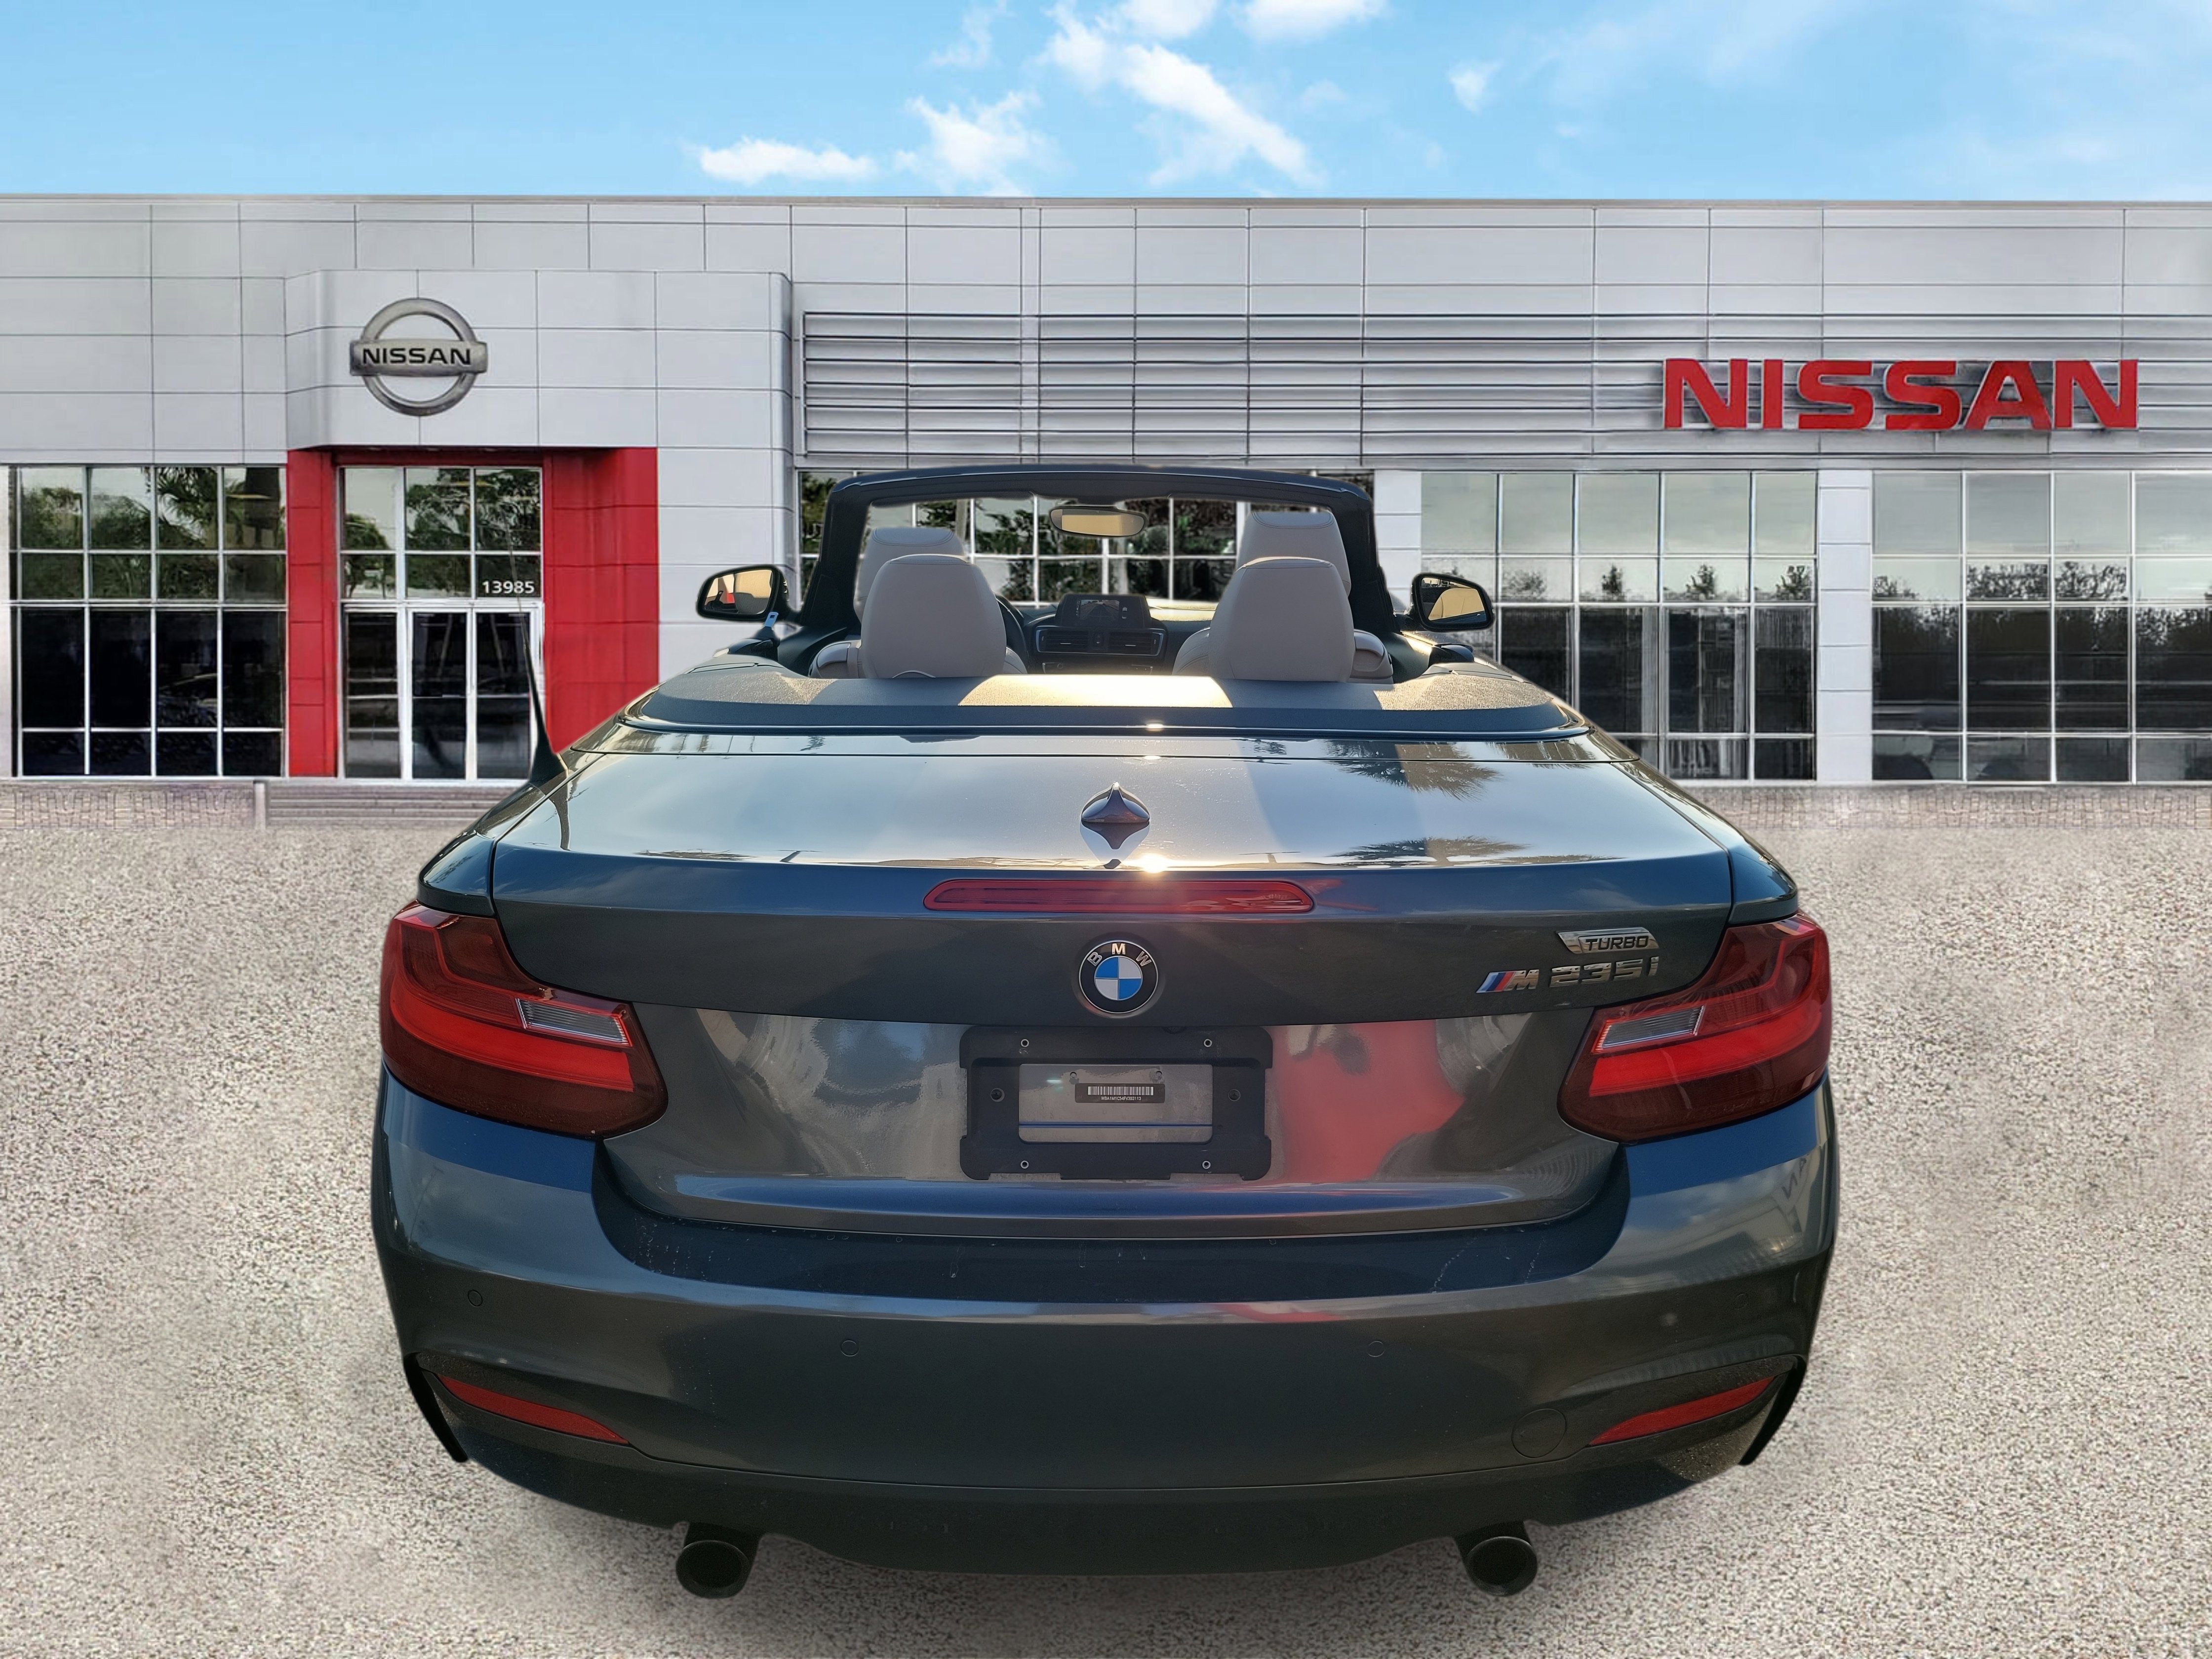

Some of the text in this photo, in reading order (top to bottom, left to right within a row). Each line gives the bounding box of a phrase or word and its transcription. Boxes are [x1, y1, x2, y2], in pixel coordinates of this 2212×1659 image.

[363, 348, 471, 365] NISSAN
[1664, 358, 2138, 430] NISSAN
[482, 580, 534, 593] 13985
[1584, 935, 1650, 951] TURBO
[1087, 943, 1152, 967] BMW
